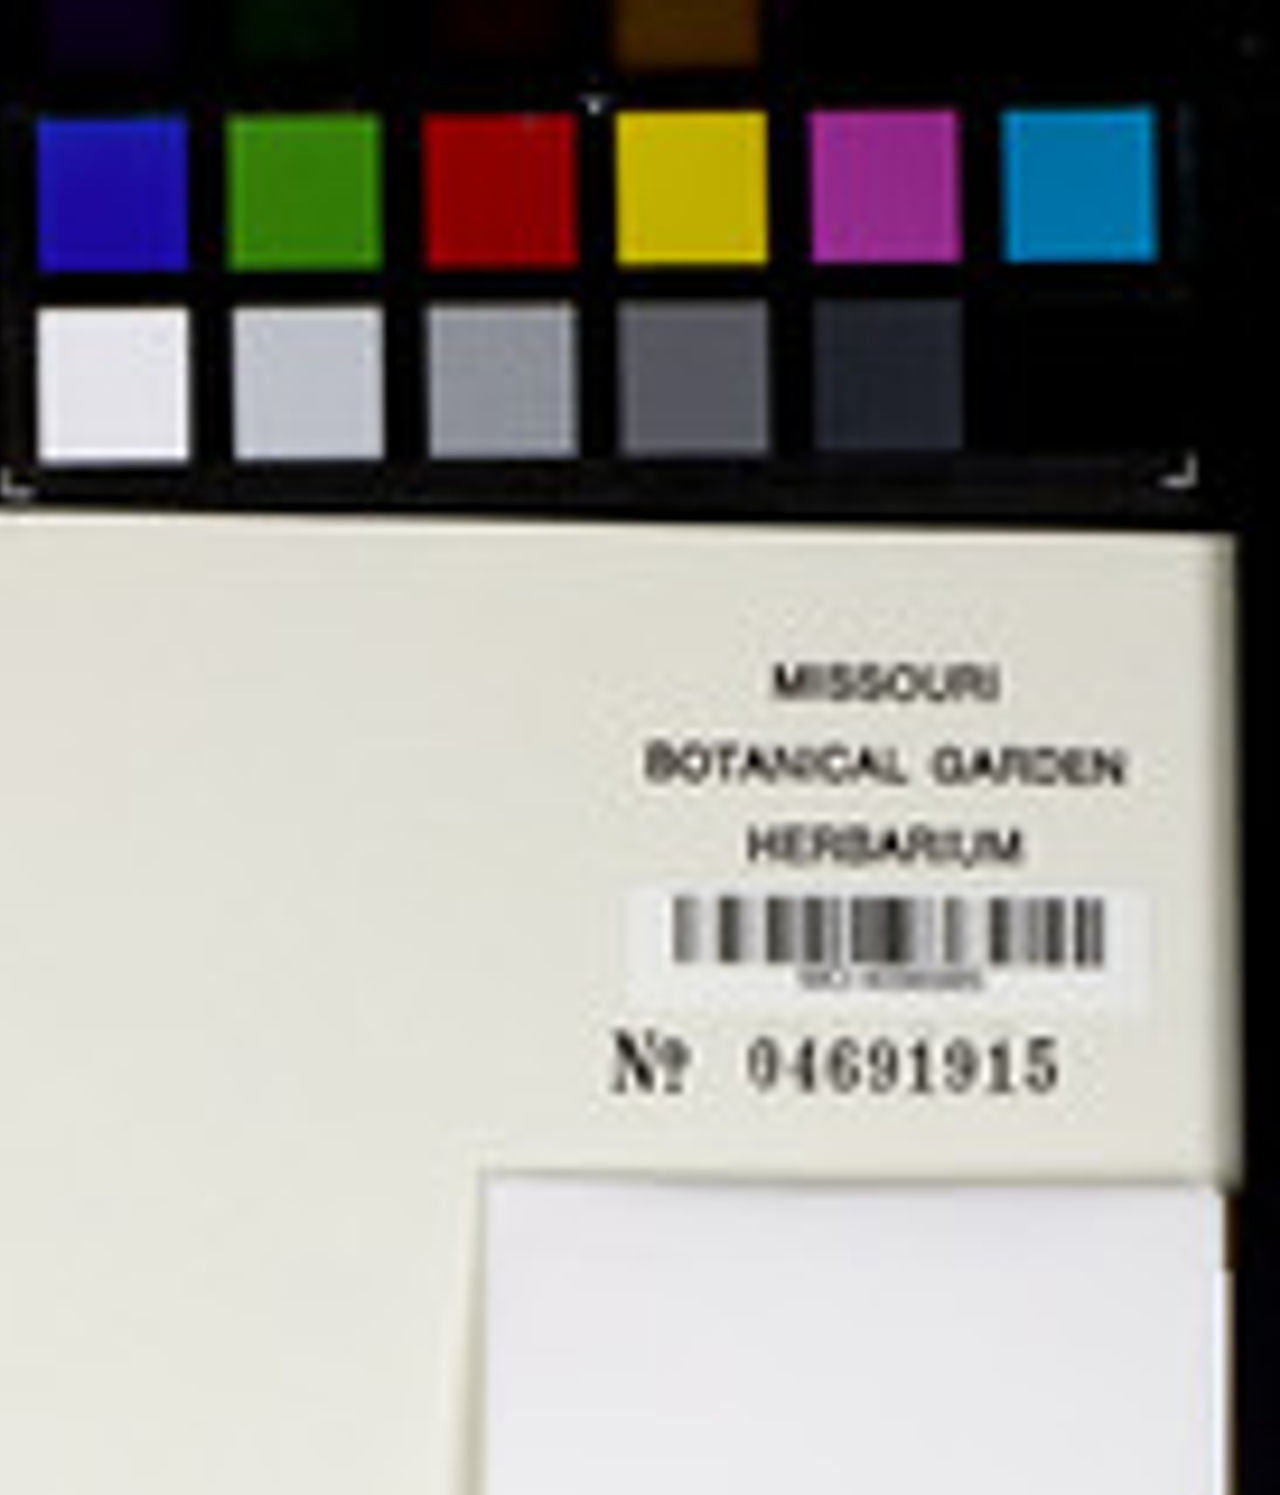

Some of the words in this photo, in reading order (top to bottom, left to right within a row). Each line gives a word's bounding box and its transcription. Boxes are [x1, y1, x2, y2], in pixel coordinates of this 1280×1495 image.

[772, 662, 1001, 704] MISSOURI
[644, 739, 909, 787] BOTANICAL
[930, 745, 1126, 787] GARDEN
[746, 824, 1023, 869] HERBARIUM
[746, 1035, 1059, 1095] 04691915
